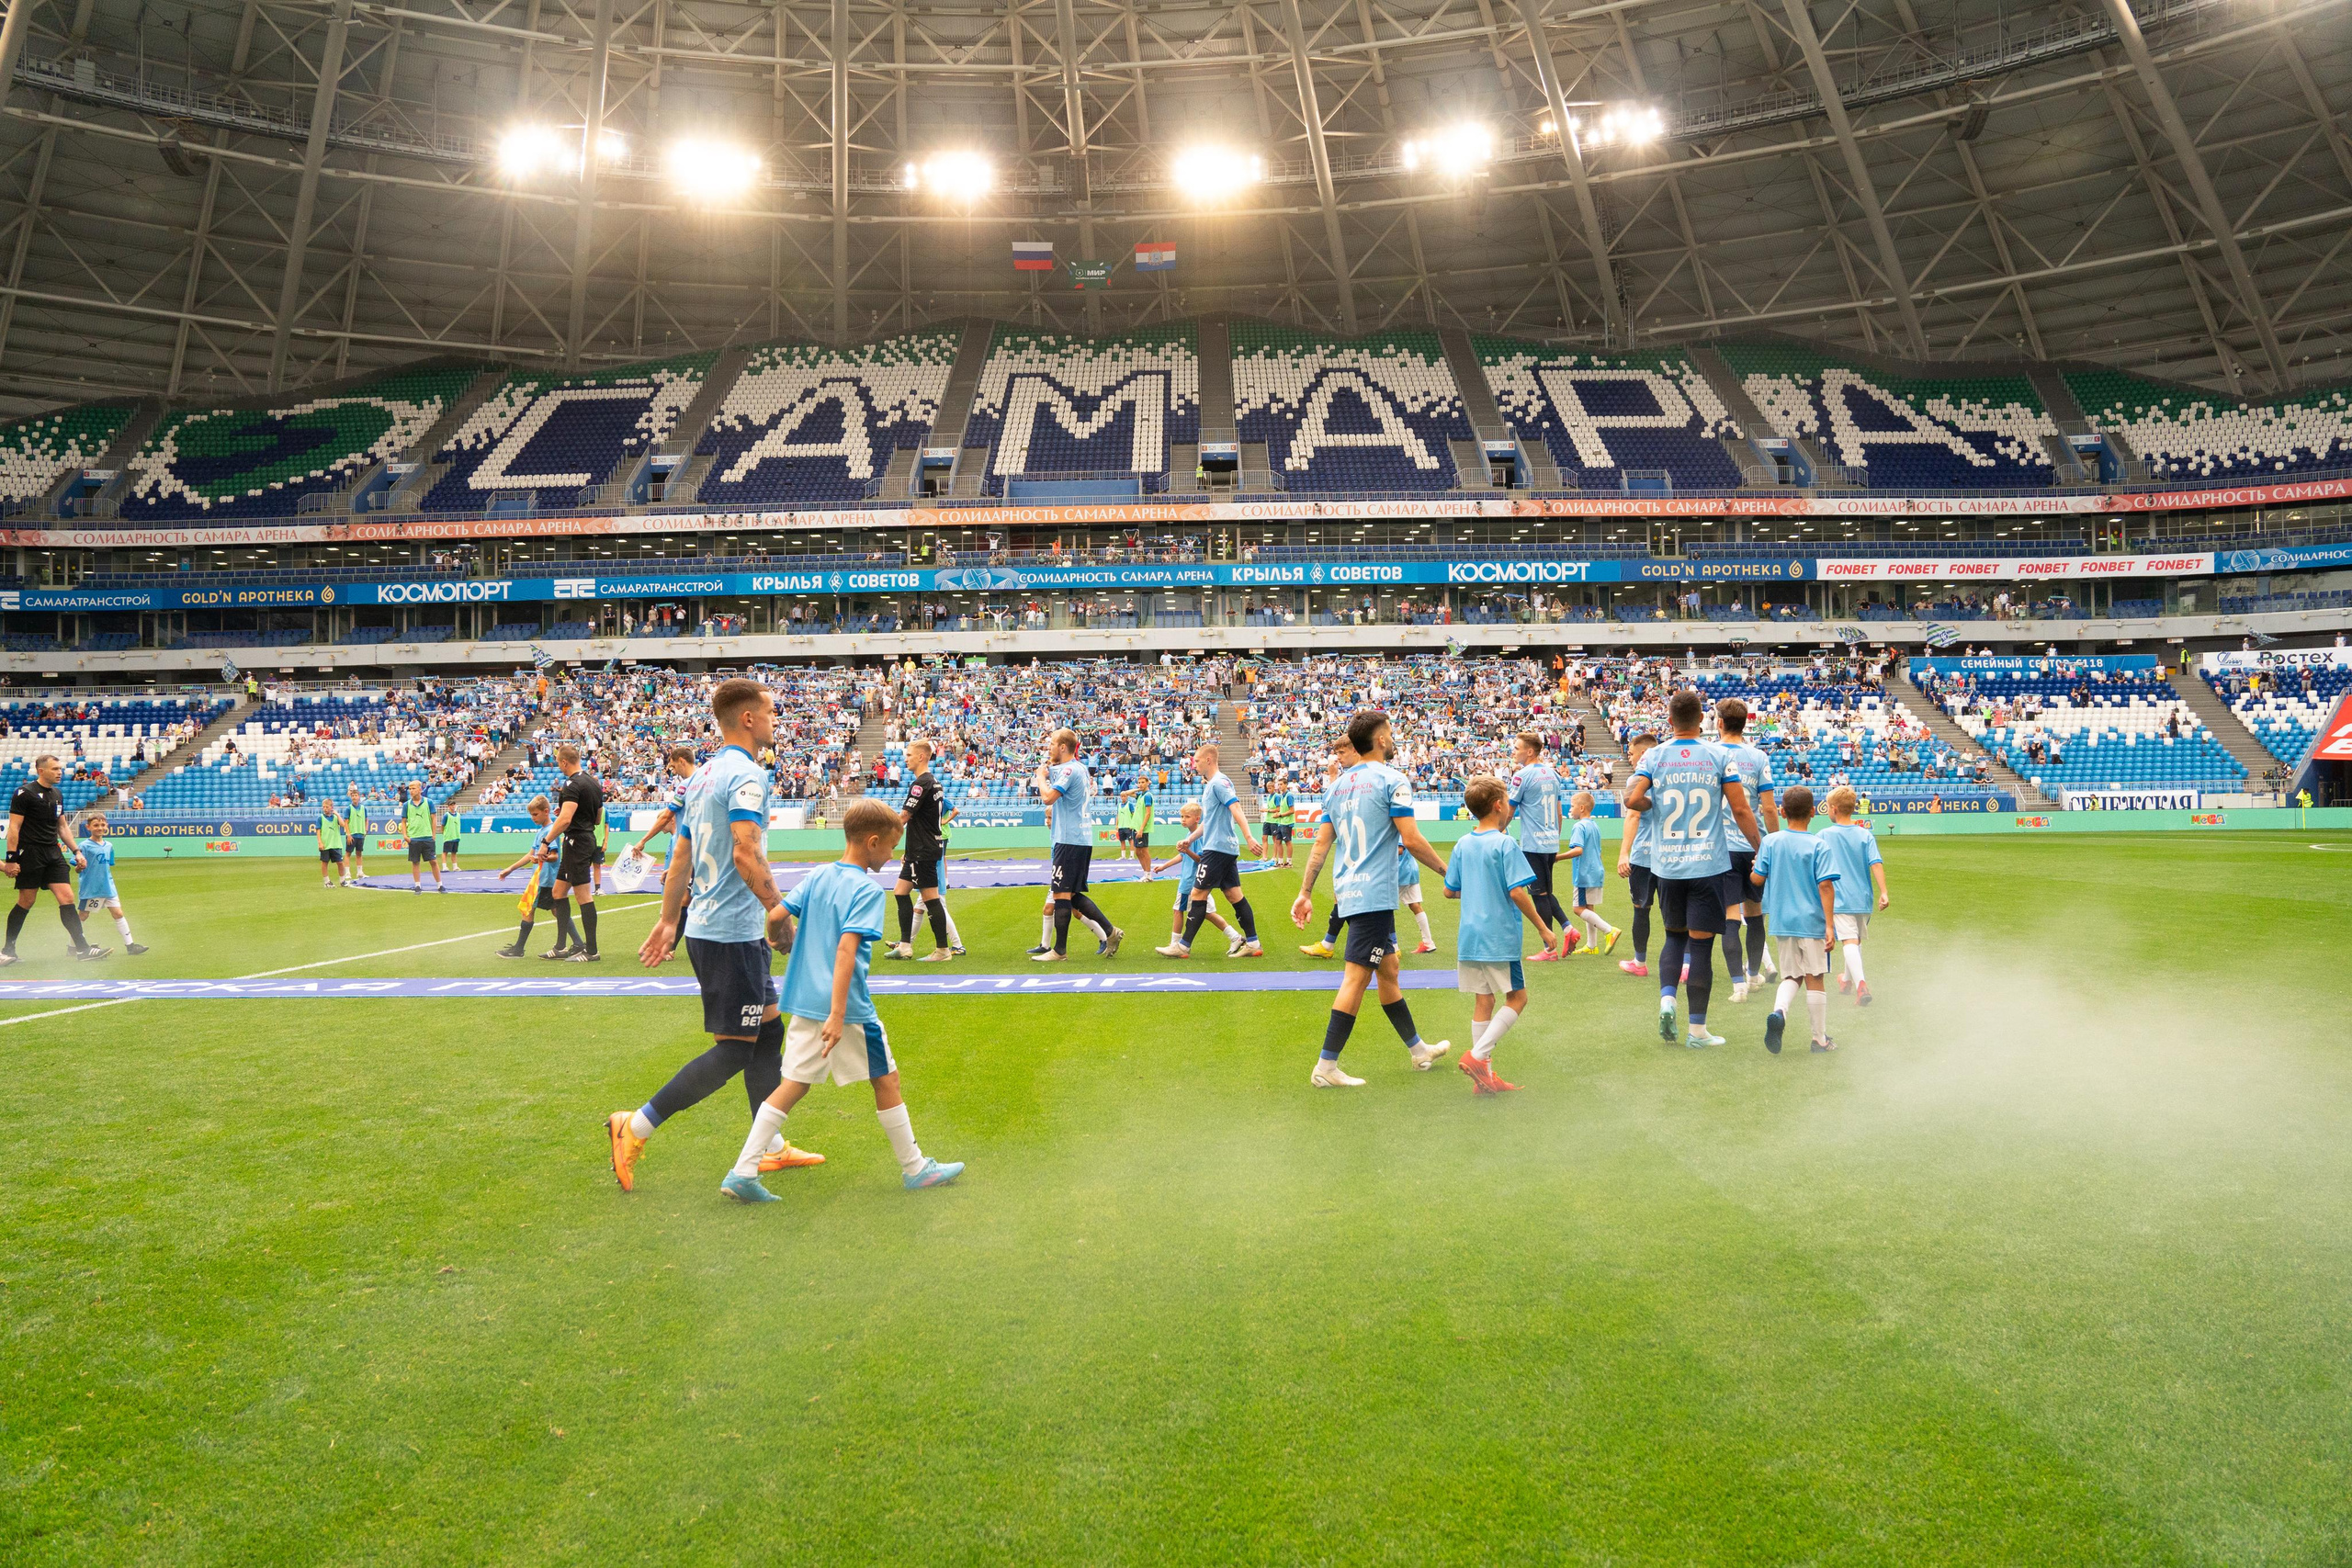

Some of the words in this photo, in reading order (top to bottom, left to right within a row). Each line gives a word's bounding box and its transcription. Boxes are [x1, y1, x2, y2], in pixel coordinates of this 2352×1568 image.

[2273, 483, 2346, 500] САМАРА
[1242, 503, 1362, 518] СОЛИДАРНОСТЬ
[1367, 503, 1429, 516] САМАРА
[1435, 502, 1478, 514] АРЕНА
[1666, 502, 1725, 513] САМАРА
[1732, 501, 1777, 513] АРЕНА
[1838, 501, 1953, 513] СОЛИДАРНОСТЬ
[1959, 500, 2018, 513] САМАРА
[2023, 500, 2069, 512] АРЕНА
[831, 513, 876, 525] АРЕНА
[939, 509, 1058, 523] СОЛИДАРНОСТЬ
[1064, 507, 1126, 521] САМАРА
[1132, 507, 1178, 520] АРЕНА
[356, 524, 469, 538] СОЛИДАРНОСТЬ
[474, 522, 535, 536] САМАРА
[538, 521, 582, 534] АРЕНА
[74, 531, 188, 546] СОЛИДАРНОСТЬ
[193, 529, 251, 543] САМАРА
[255, 529, 298, 542] АРЕНА
[1232, 567, 1304, 581] КРЫЛЬЯ
[1330, 566, 1402, 581] СОВЕТОВ
[1448, 562, 1590, 581] КОСМОПОРТ
[1702, 564, 1781, 575] APOTHEKA
[1826, 564, 1878, 575] FONBET
[1888, 564, 1939, 574] FONBET
[1950, 563, 1999, 574] FONBET
[2018, 562, 2069, 573] FONBET
[2080, 561, 2135, 573] FONBET
[2146, 558, 2203, 571] FONBET
[753, 574, 822, 591] КРЫЛЬЯ
[849, 573, 920, 588] СОВЕТОВ
[1019, 570, 1116, 584] СОЛИДАРНОСТЬ
[1121, 570, 1172, 582] САМАРА
[1176, 570, 1214, 581] АРЕНА
[378, 581, 513, 603] КОСМОПОРТ
[601, 579, 723, 594] САМАРАТРАНССТРОЙ
[26, 592, 151, 607] САМАРАТРАНССТРОЙ
[239, 590, 314, 603] APOTHEKA
[1961, 658, 2023, 669] СЕМЕЙНЫЙ
[1667, 772, 1718, 787] КОСТАНЗА
[1542, 794, 1555, 827] 11
[1663, 788, 1711, 840] 22
[143, 825, 213, 836] APOTHEKA
[1668, 854, 1713, 863] APOTHEKA
[910, 863, 917, 876] 1
[1196, 863, 1207, 878] 15
[741, 1004, 764, 1015] FON
[741, 1016, 763, 1027] BET
